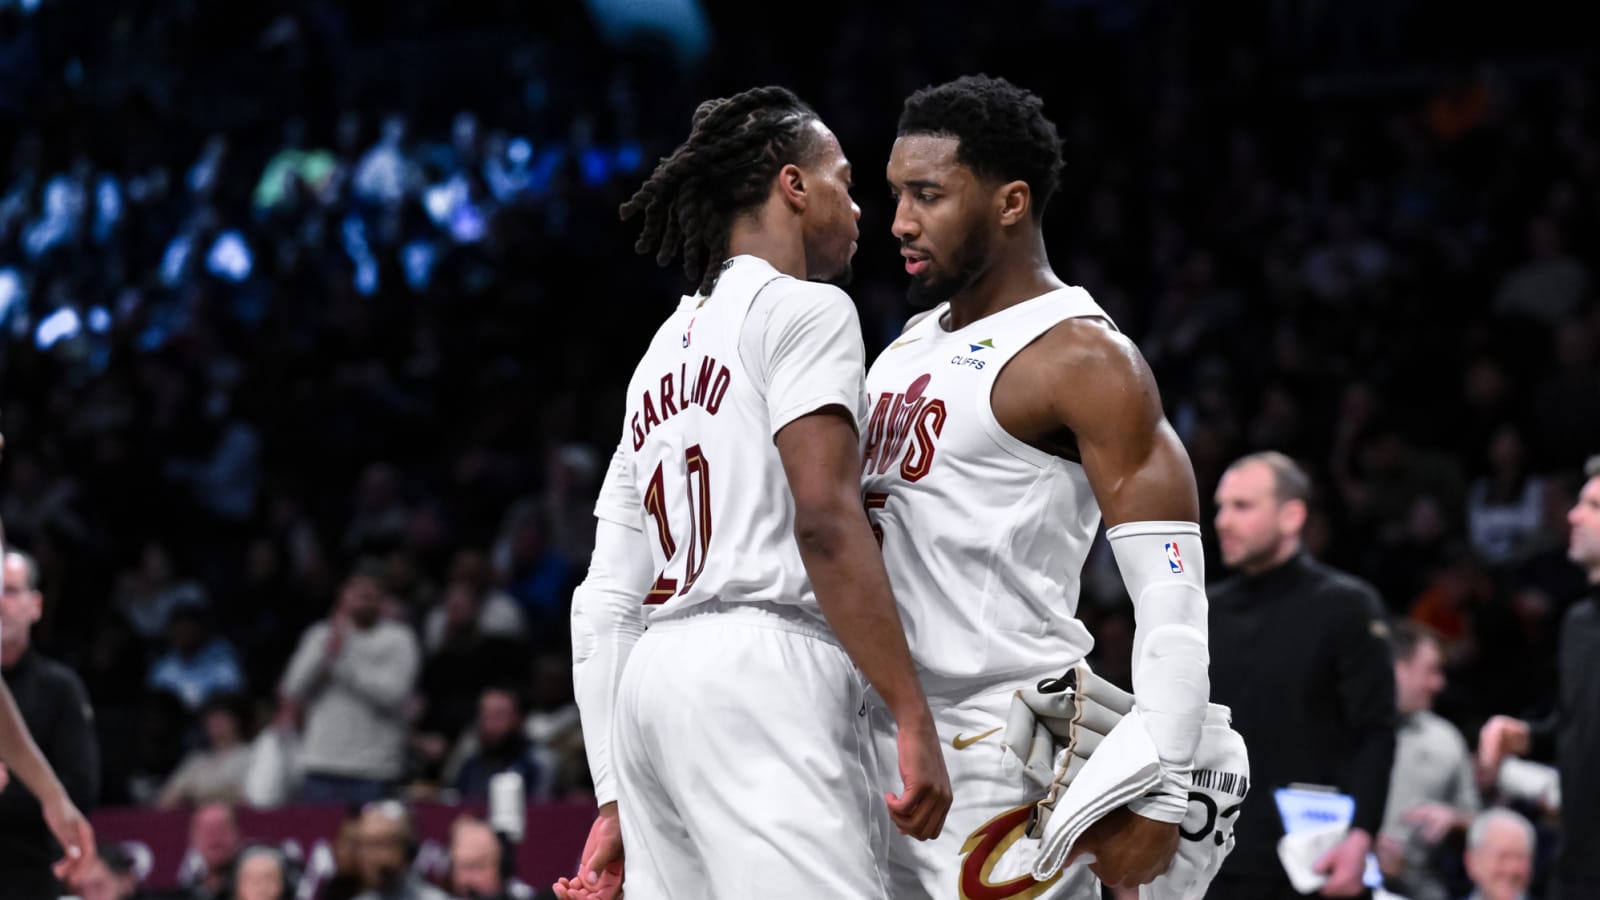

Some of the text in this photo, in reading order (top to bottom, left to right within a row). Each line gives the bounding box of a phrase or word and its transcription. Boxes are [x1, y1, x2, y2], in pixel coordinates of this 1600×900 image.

[951, 355, 986, 370] CLIFFS
[863, 391, 947, 483] AVS
[643, 444, 712, 605] 10
